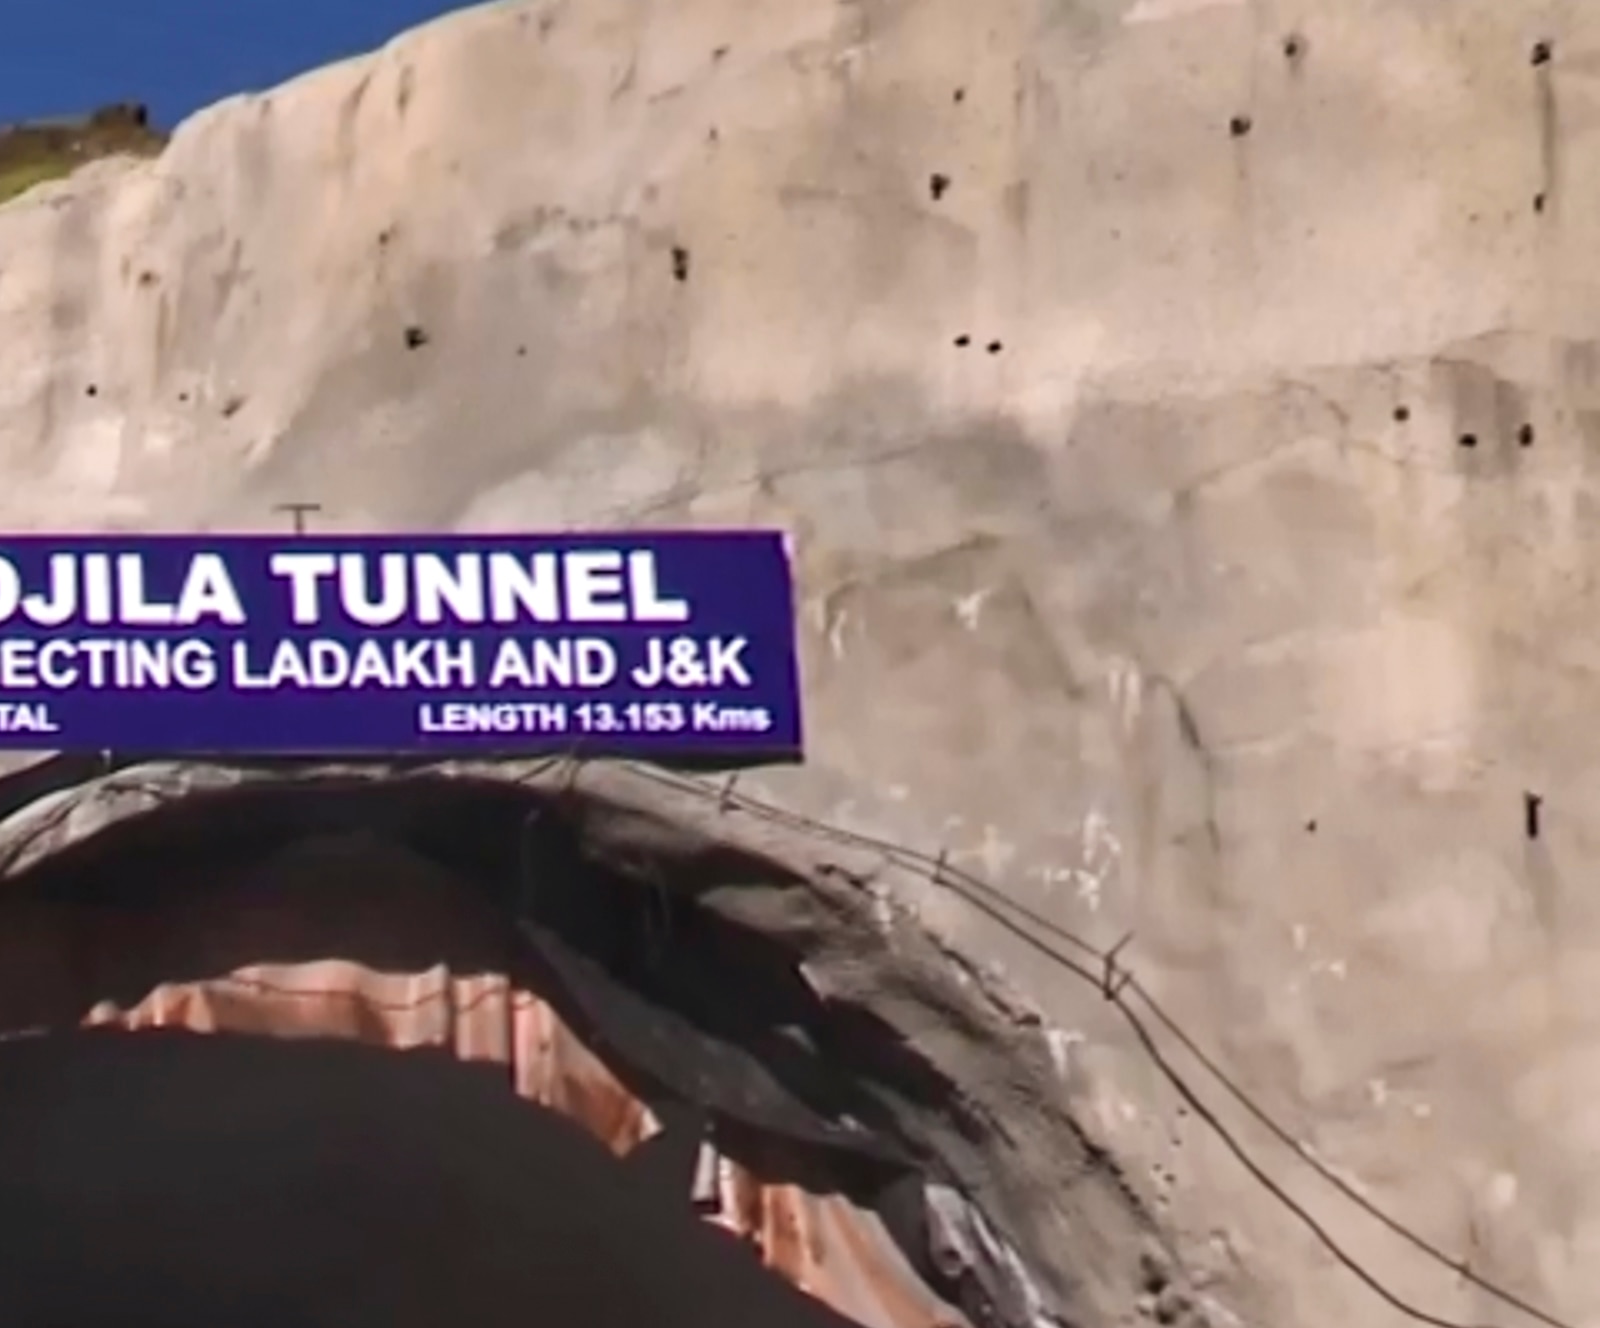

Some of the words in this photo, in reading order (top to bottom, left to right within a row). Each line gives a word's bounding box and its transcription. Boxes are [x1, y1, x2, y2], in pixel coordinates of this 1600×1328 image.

[270, 550, 690, 626] TUNNEL
[232, 638, 475, 689] LADAKH
[489, 638, 617, 688] AND
[632, 636, 752, 688] J&K
[419, 703, 567, 733] LENGTH
[573, 703, 685, 733] 13.153
[692, 703, 772, 733] Kms
